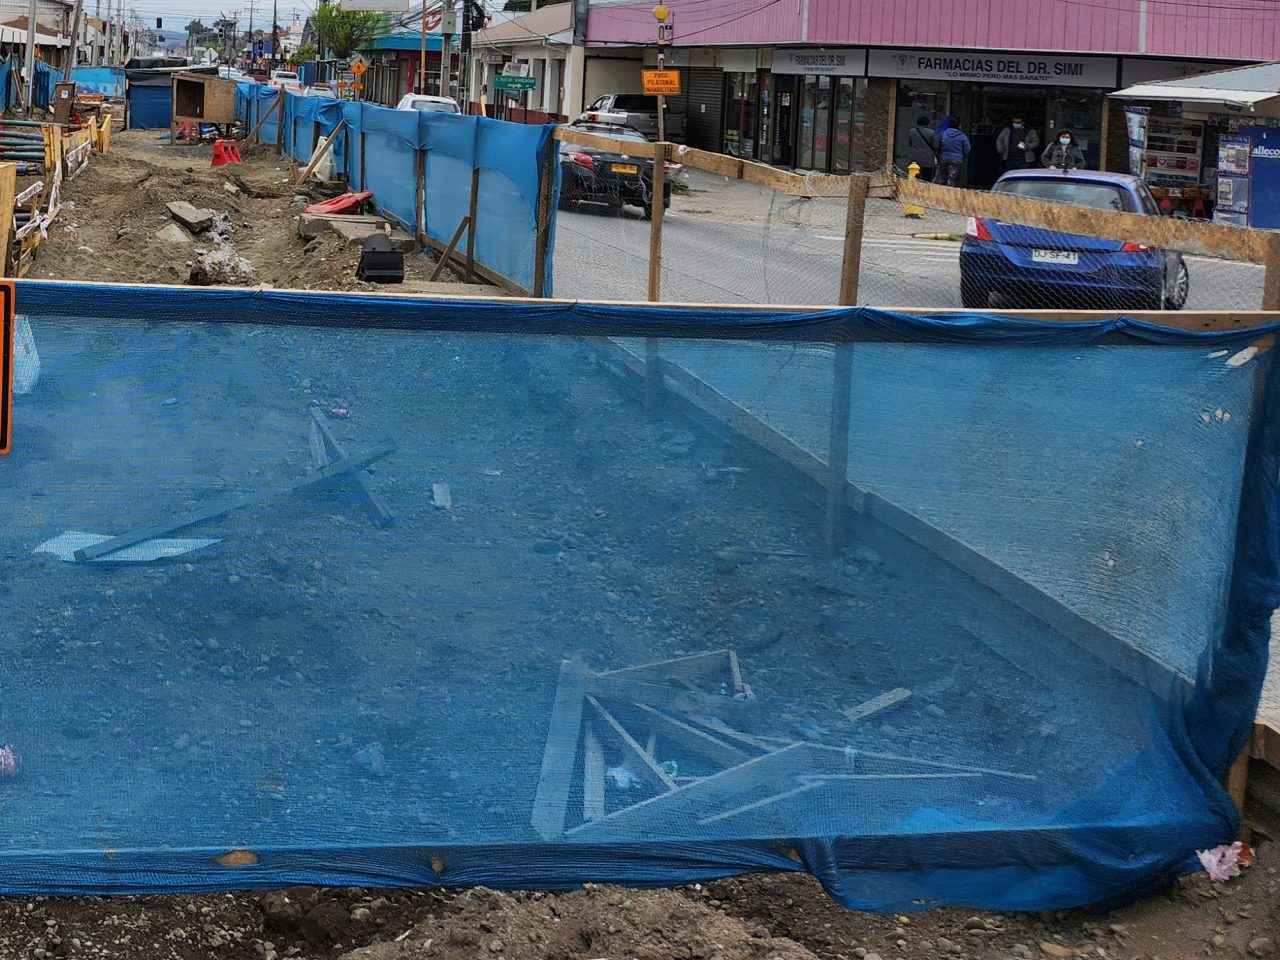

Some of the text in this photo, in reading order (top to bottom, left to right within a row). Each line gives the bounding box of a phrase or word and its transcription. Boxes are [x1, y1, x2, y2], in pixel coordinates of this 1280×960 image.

[918, 56, 993, 73] FARMACIAS
[996, 59, 1025, 74] DEL
[1027, 60, 1051, 75] DR.
